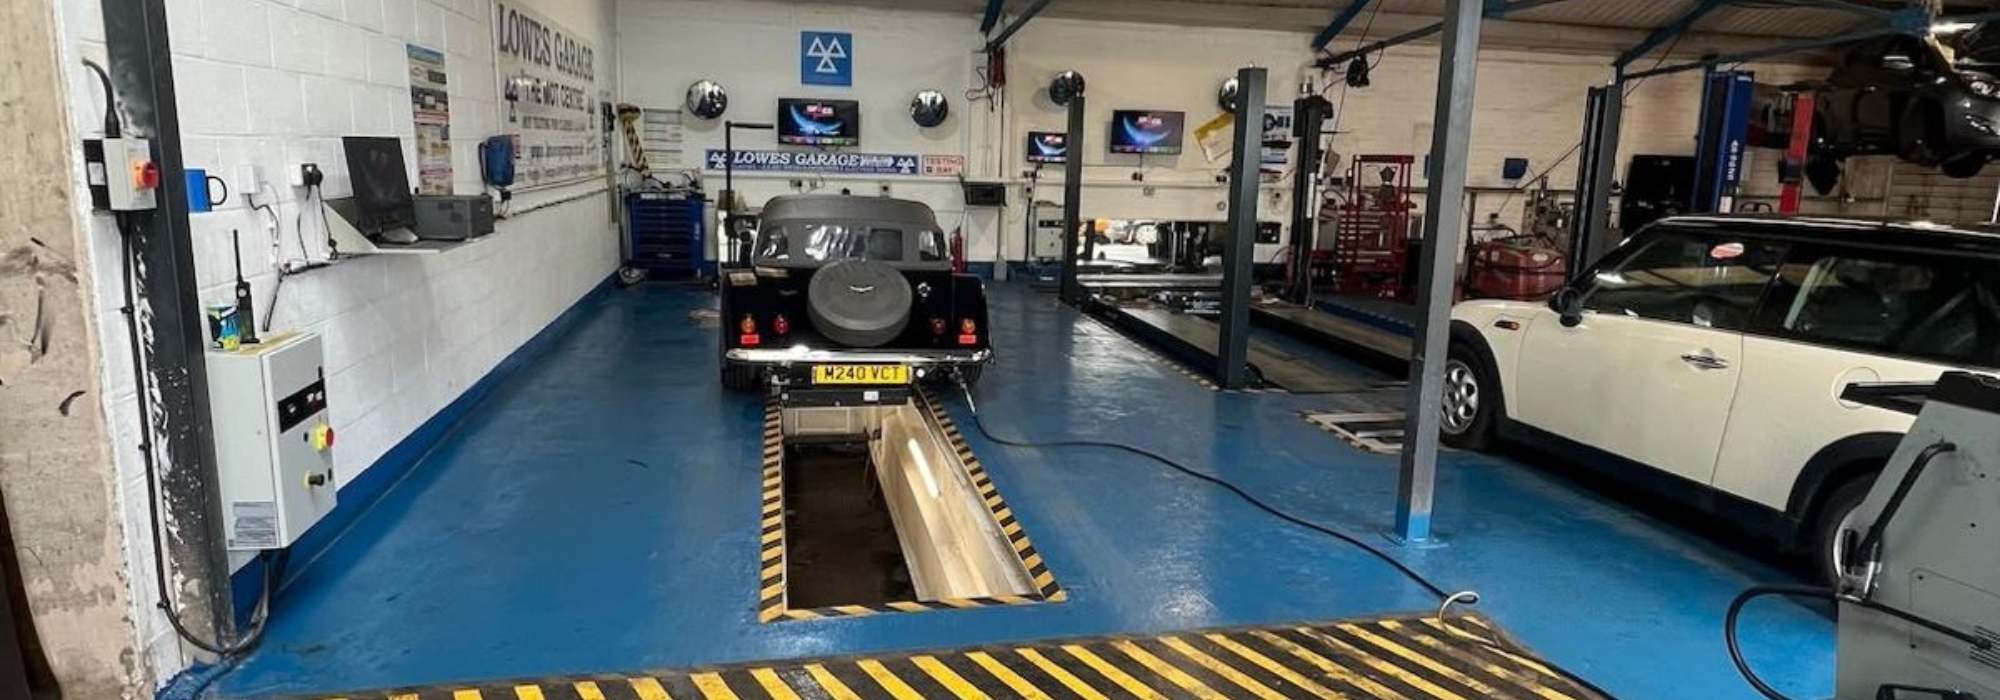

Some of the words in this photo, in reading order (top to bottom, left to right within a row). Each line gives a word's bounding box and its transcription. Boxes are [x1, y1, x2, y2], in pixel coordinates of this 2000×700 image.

[498, 3, 551, 68] LOWES
[554, 31, 594, 82] GARAGE
[733, 152, 791, 165] LOWES
[795, 153, 861, 167] GARAGE
[824, 366, 866, 381] M240
[871, 366, 900, 381] VCT
